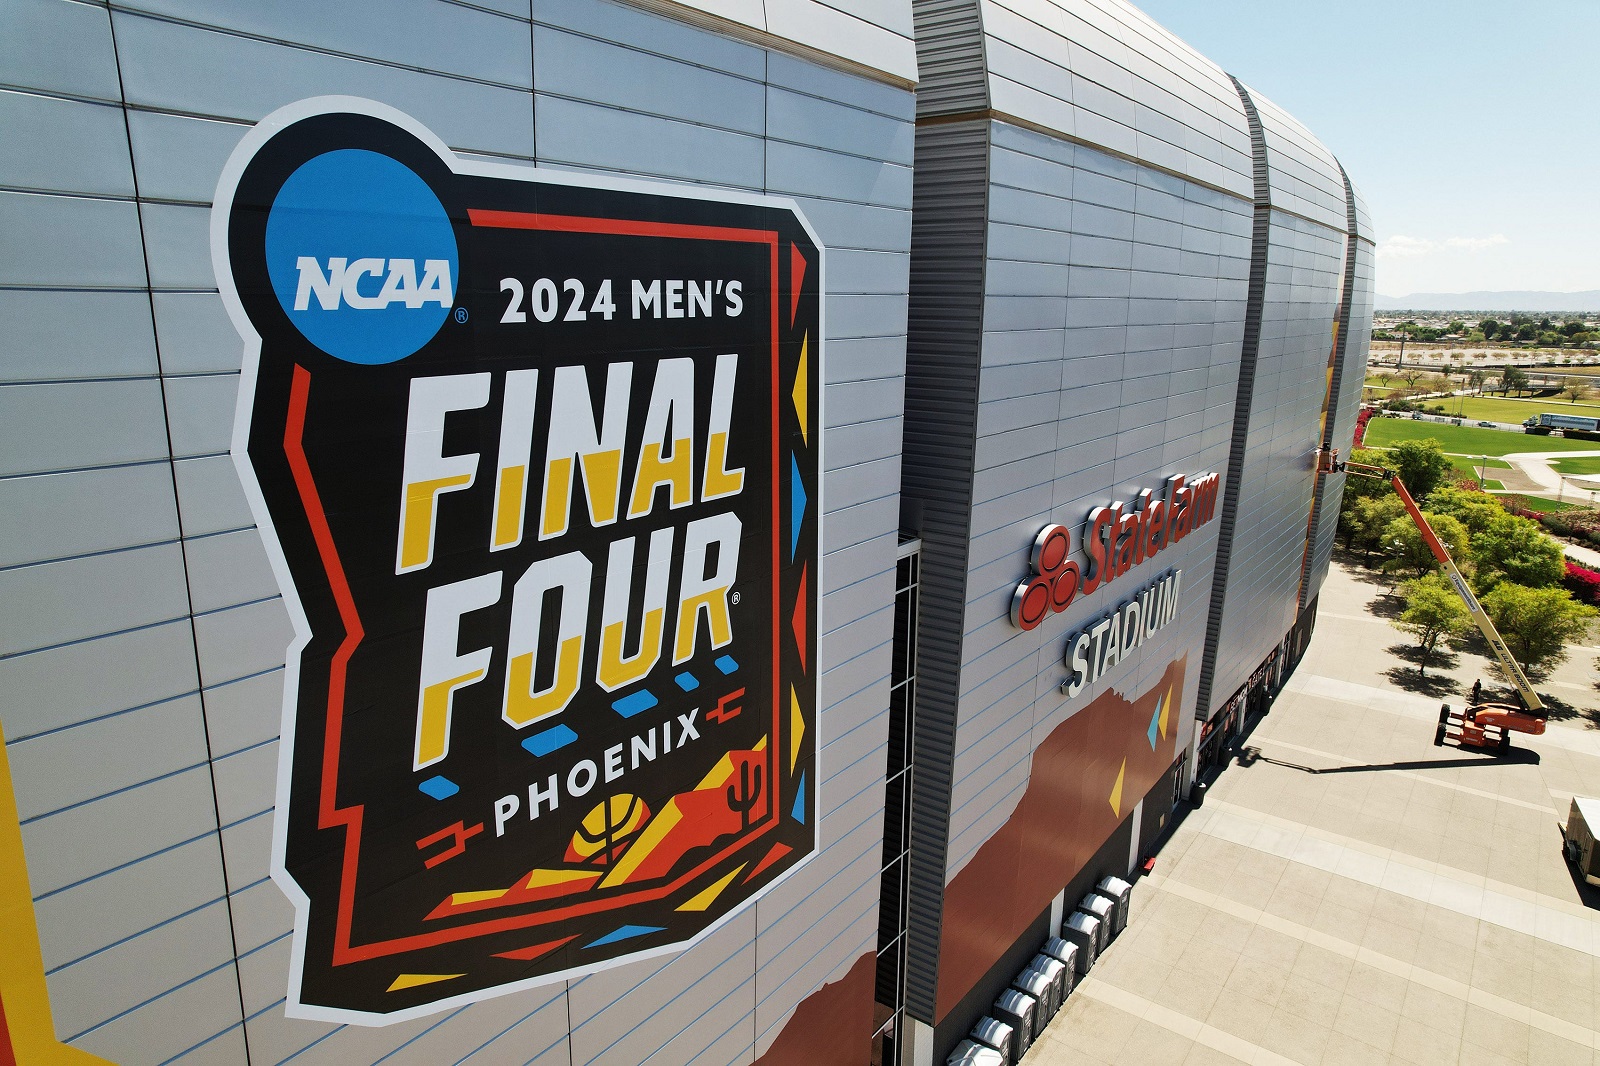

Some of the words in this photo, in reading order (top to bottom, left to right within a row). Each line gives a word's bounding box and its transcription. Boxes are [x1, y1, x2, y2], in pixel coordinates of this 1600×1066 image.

[294, 256, 454, 311] NCAA
[499, 277, 616, 324] 2024
[631, 279, 744, 320] MEN'S
[395, 353, 746, 576] FINAL
[412, 511, 743, 772] FOUR
[1063, 569, 1182, 699] STADIUM
[493, 707, 702, 837] PHOENIX
